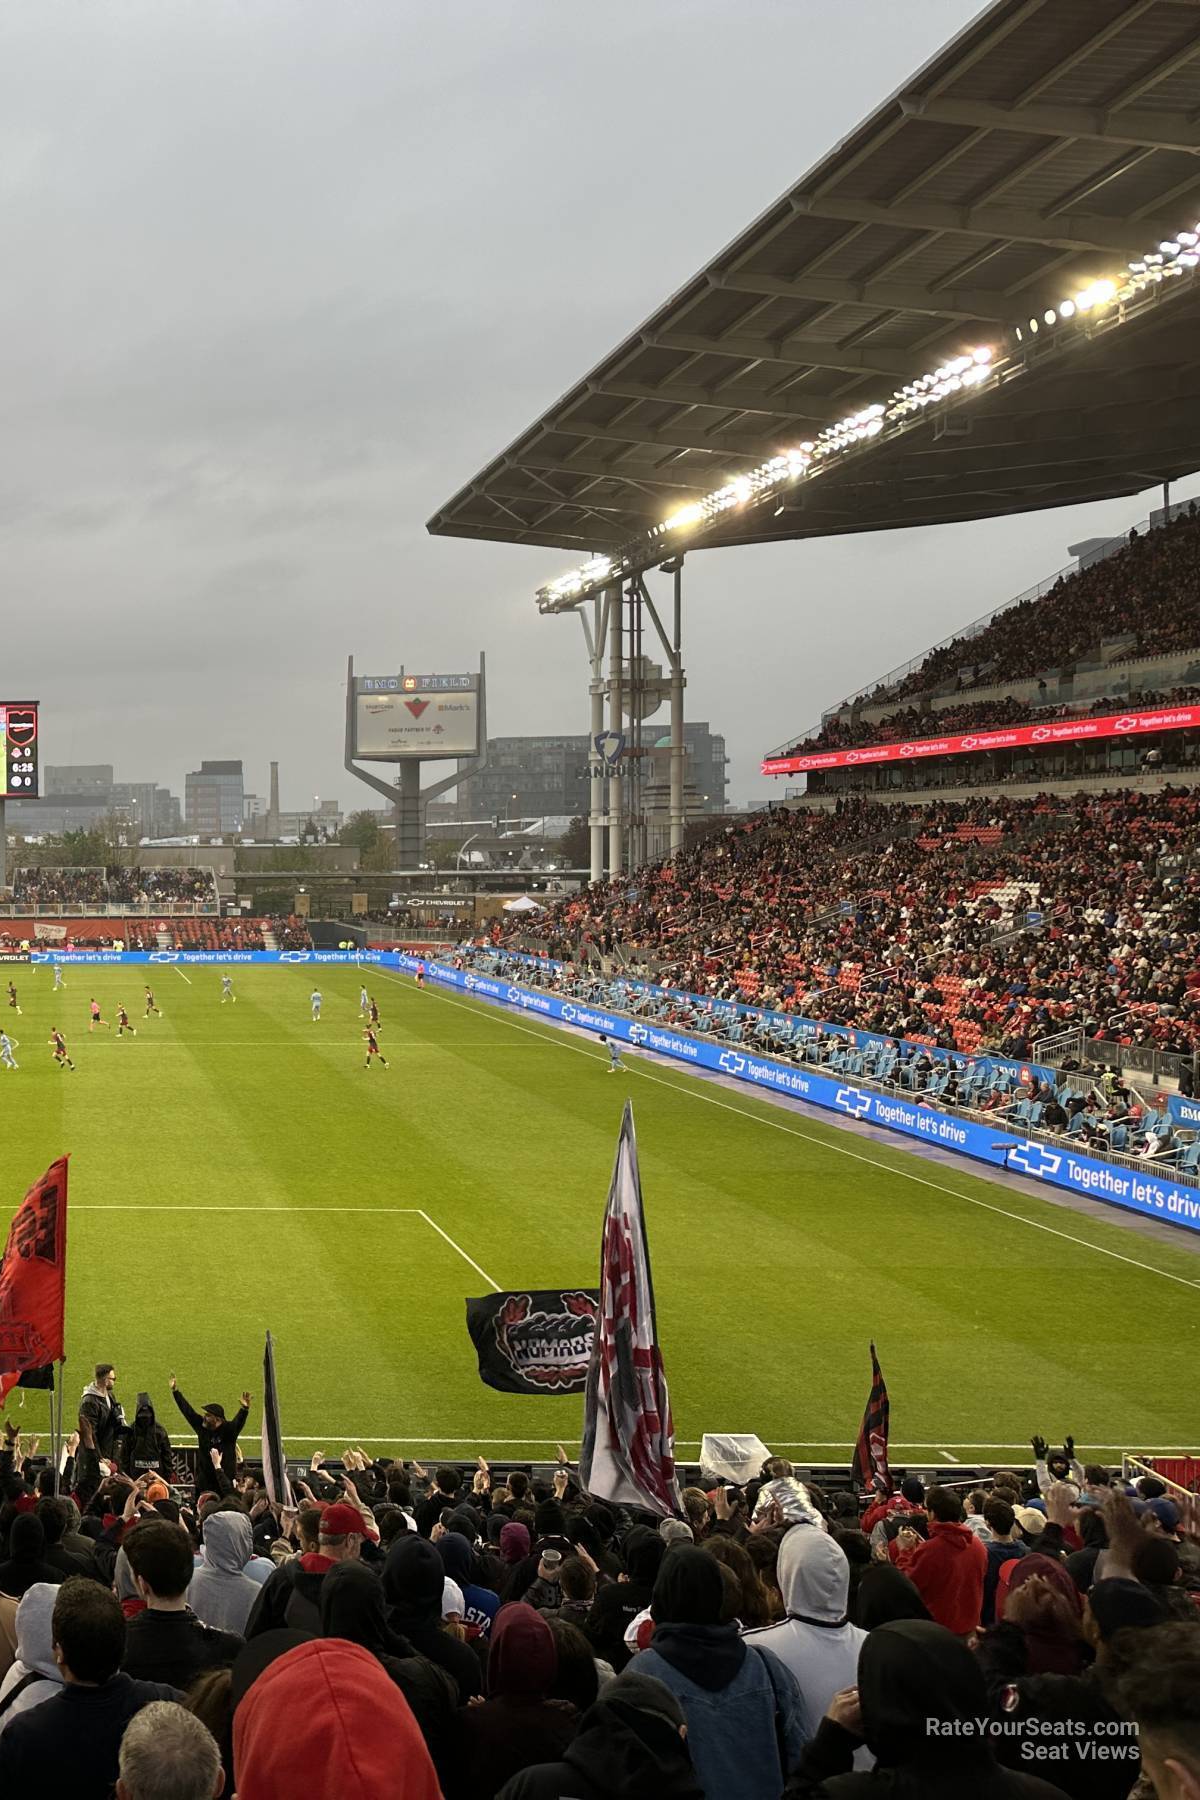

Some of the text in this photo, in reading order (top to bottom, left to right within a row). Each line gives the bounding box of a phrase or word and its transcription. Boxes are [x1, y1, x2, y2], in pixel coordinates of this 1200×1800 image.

[422, 678, 470, 688] FIELD
[24, 748, 31, 757] 0
[12, 763, 34, 772] 6:25
[24, 777, 31, 786] 0
[53, 953, 121, 962] Together let's drive
[183, 953, 215, 962] Together
[314, 953, 347, 962] Together
[649, 1031, 670, 1048] Together
[682, 1041, 698, 1057] drive
[747, 1060, 809, 1093] Together let's drive
[875, 1099, 966, 1144] Together let's drive
[1067, 1159, 1200, 1218] Together let's driv
